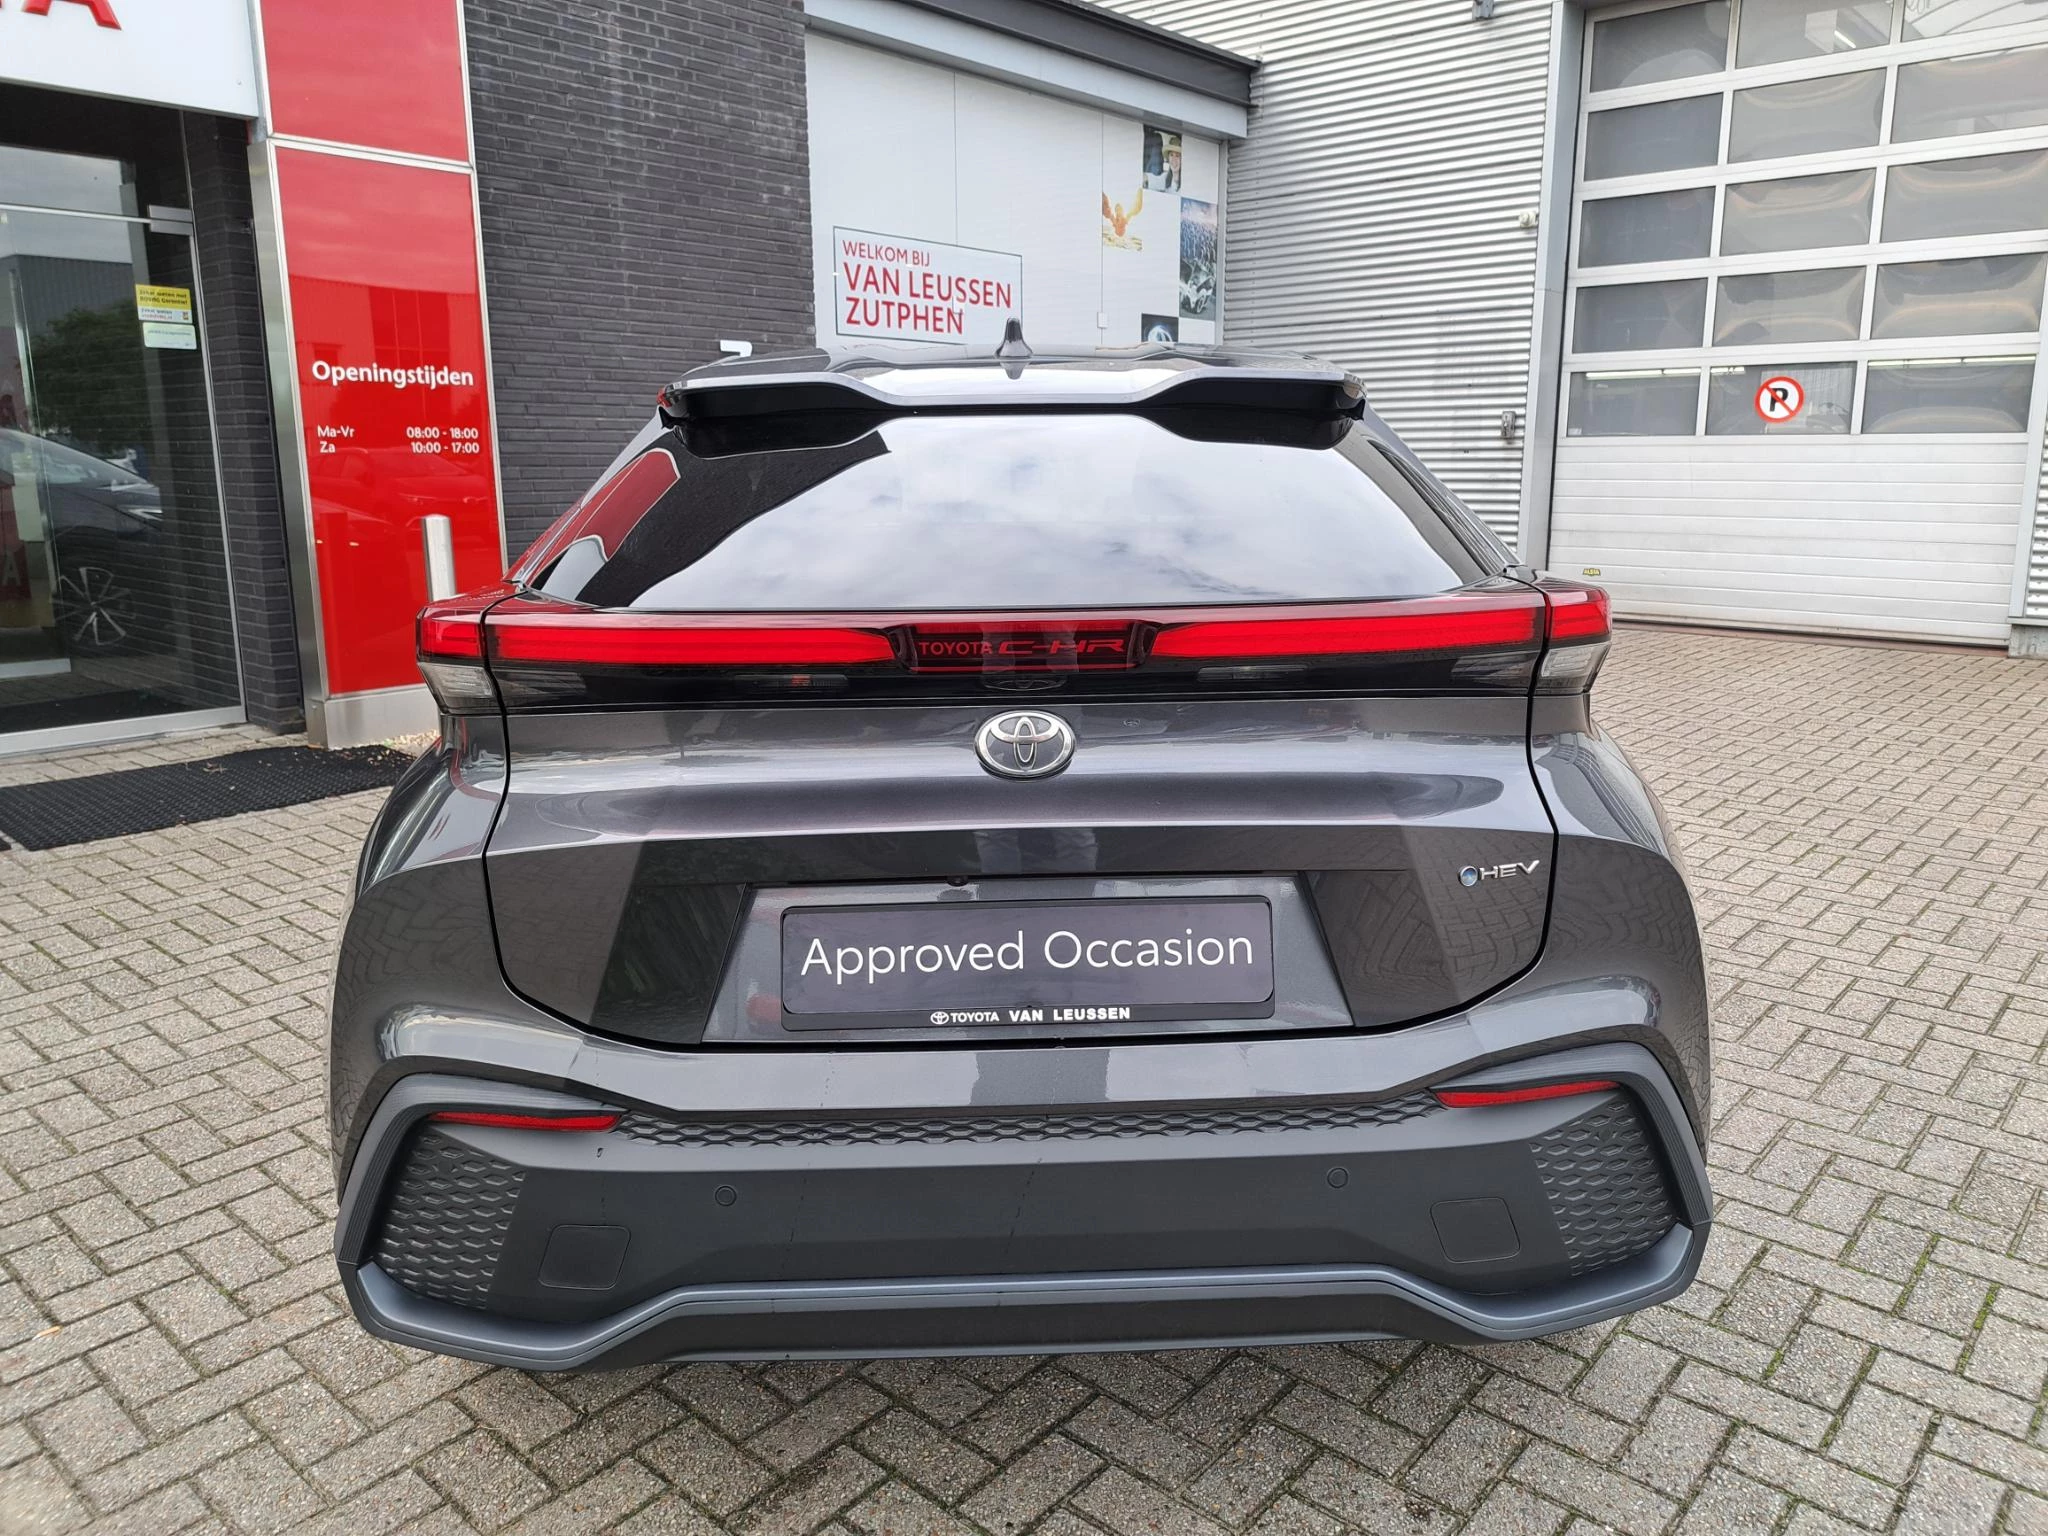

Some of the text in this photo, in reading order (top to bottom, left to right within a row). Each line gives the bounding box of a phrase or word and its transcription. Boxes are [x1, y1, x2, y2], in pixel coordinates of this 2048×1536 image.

[842, 239, 930, 267] WELKOM BIJ
[843, 261, 1012, 309] VAN LEUSSEN
[845, 296, 963, 335] ZUTPHEN
[312, 360, 474, 390] Openingstijden
[317, 424, 355, 438] Ma-Vr
[406, 427, 440, 439] 08:00
[449, 427, 479, 439] 18:00
[319, 441, 336, 453] Za
[411, 442, 441, 454] 10:00
[451, 442, 480, 454] 17:00
[919, 639, 1125, 656] TOYOTA C-HR
[1479, 860, 1540, 880] HEV
[800, 928, 1254, 985] Approved Occasion
[950, 1007, 1131, 1023] TOYOTA VAN LEUSSEN
